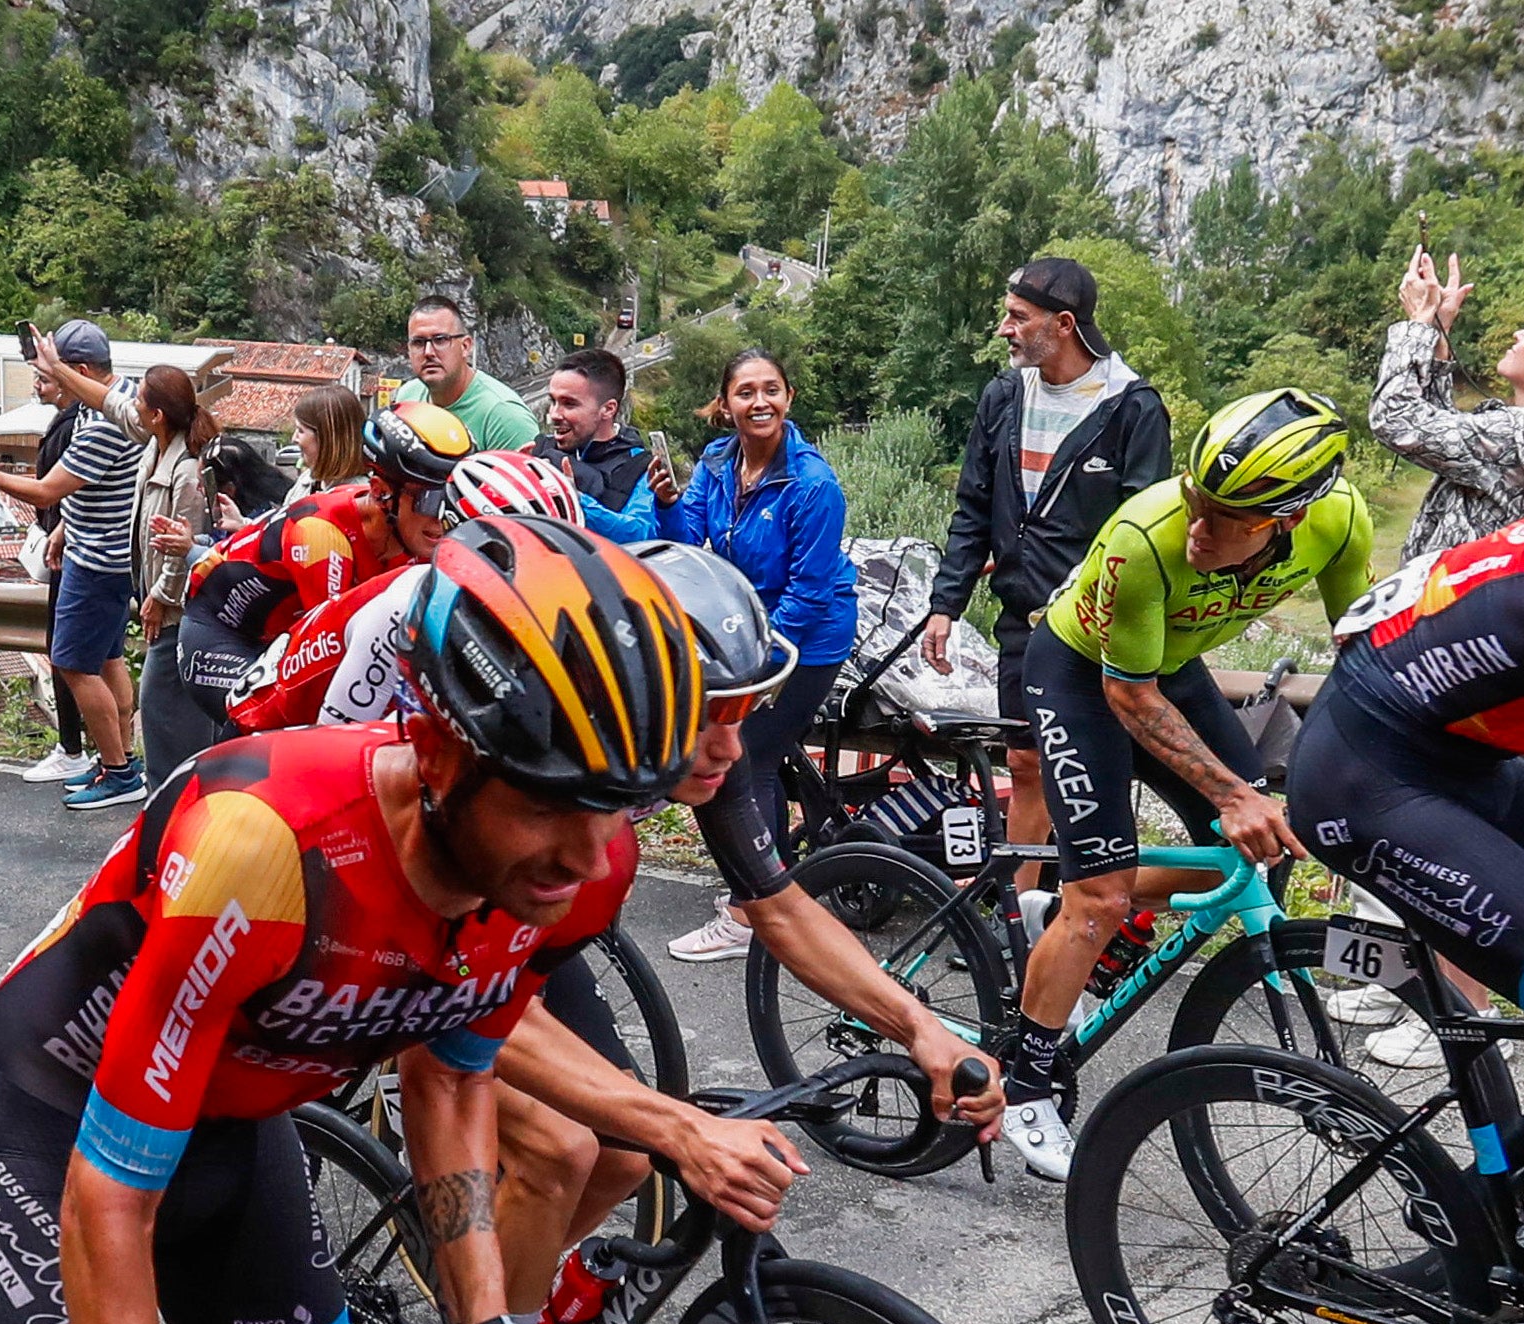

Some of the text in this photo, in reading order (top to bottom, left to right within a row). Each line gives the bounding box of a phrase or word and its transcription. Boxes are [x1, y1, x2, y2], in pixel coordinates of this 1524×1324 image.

[217, 577, 272, 629] BAHRAIN
[282, 631, 342, 681] cofidis
[349, 610, 401, 709] Cofid
[1394, 634, 1517, 704] BAHRAIN
[1036, 707, 1100, 825] ARKEA
[951, 817, 976, 857] 173
[1351, 838, 1514, 948] friendly
[1393, 846, 1472, 888] BUSINESS
[372, 950, 406, 967] NBB
[1339, 939, 1384, 980] 46
[144, 898, 251, 1102] MERIDA
[275, 962, 527, 1021] BAHRAIN
[232, 1045, 359, 1079] Bapc
